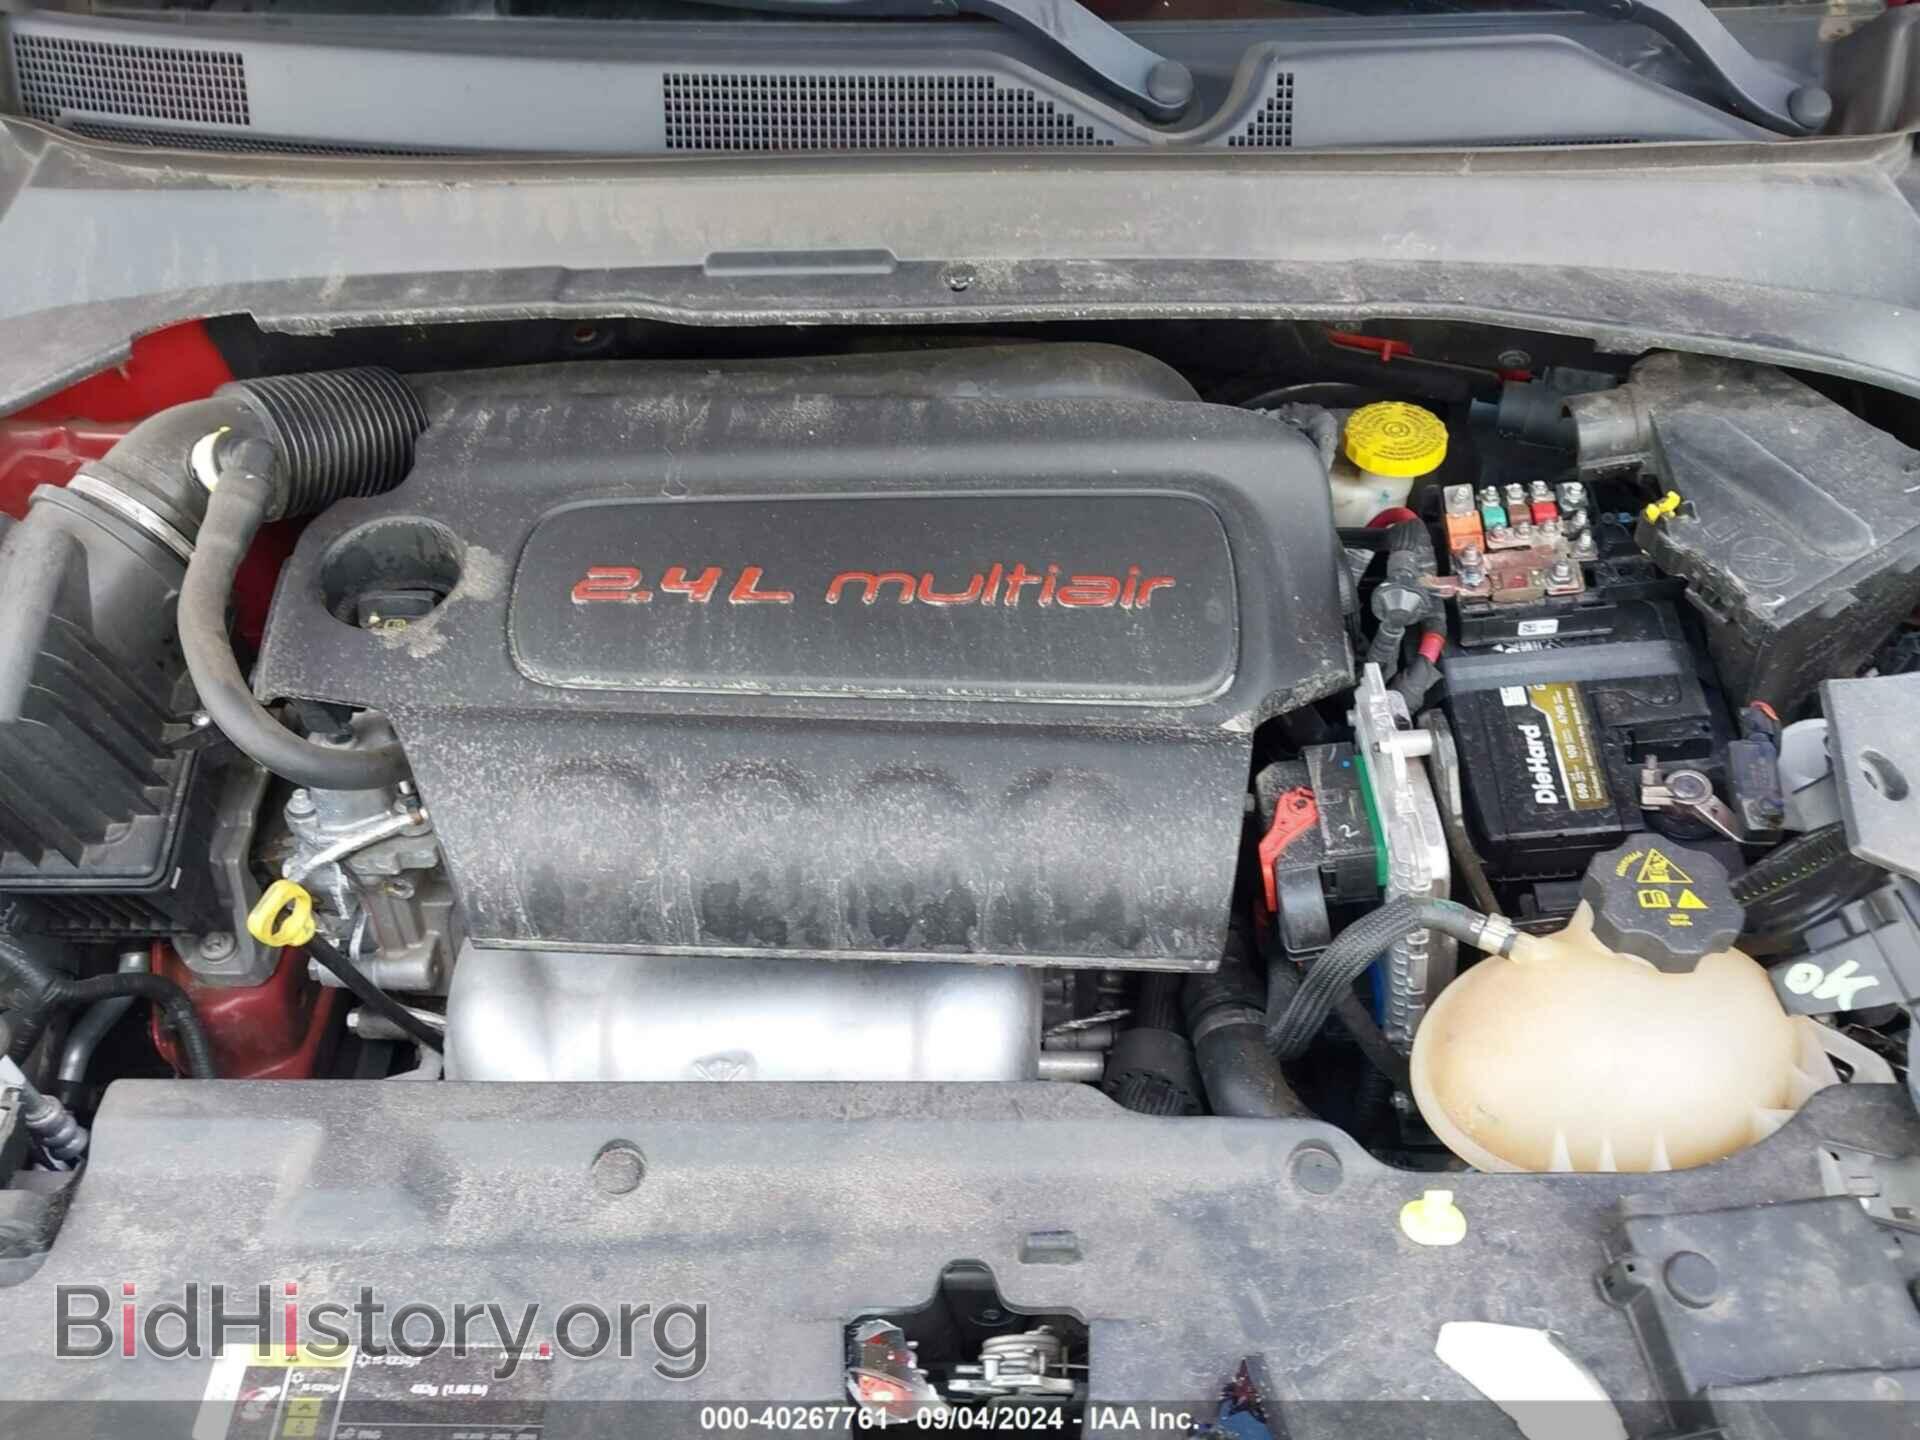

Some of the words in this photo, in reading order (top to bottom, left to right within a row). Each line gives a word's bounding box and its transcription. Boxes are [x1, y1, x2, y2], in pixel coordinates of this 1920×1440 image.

[825, 562, 1177, 609] multiair
[1517, 724, 1559, 804] DieHard
[1784, 960, 1880, 1011] OK
